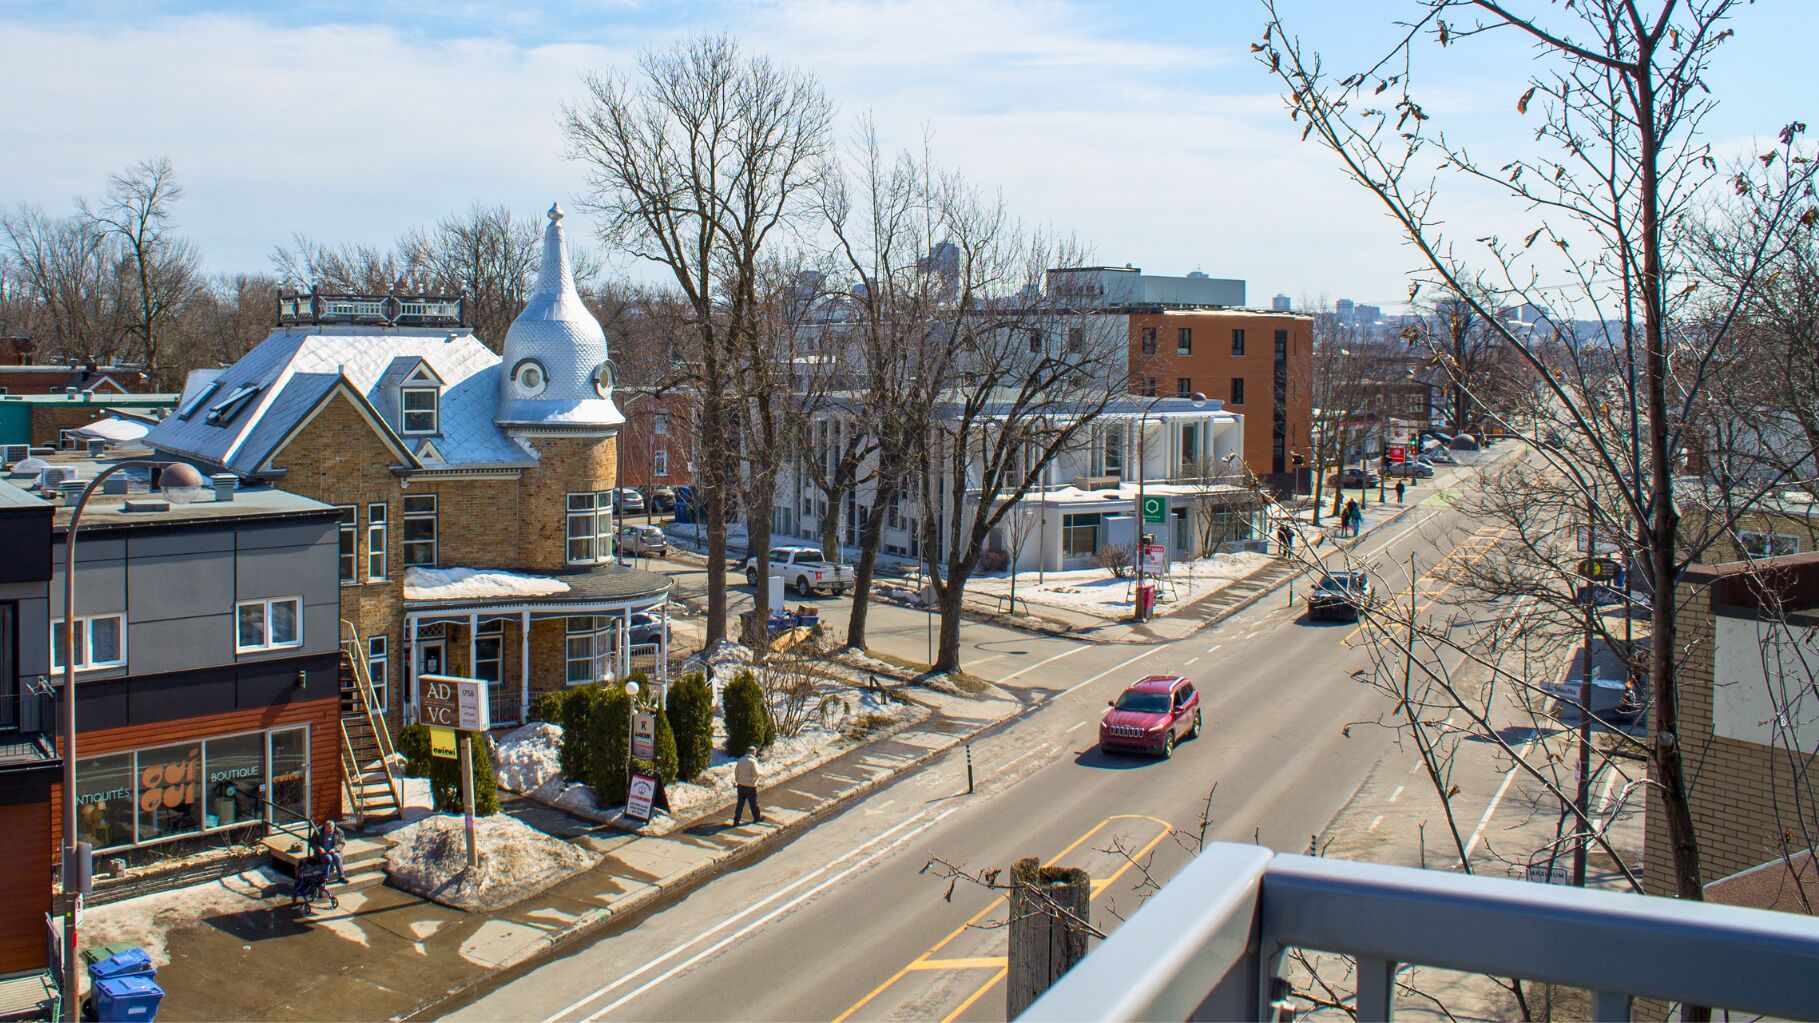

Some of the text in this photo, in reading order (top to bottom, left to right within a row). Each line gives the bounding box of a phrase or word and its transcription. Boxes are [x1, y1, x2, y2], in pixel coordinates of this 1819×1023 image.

[427, 682, 451, 700] AD
[428, 706, 451, 725] VC
[211, 766, 259, 783] BOUTIQUE
[76, 787, 130, 806] NTIQUITÉS
